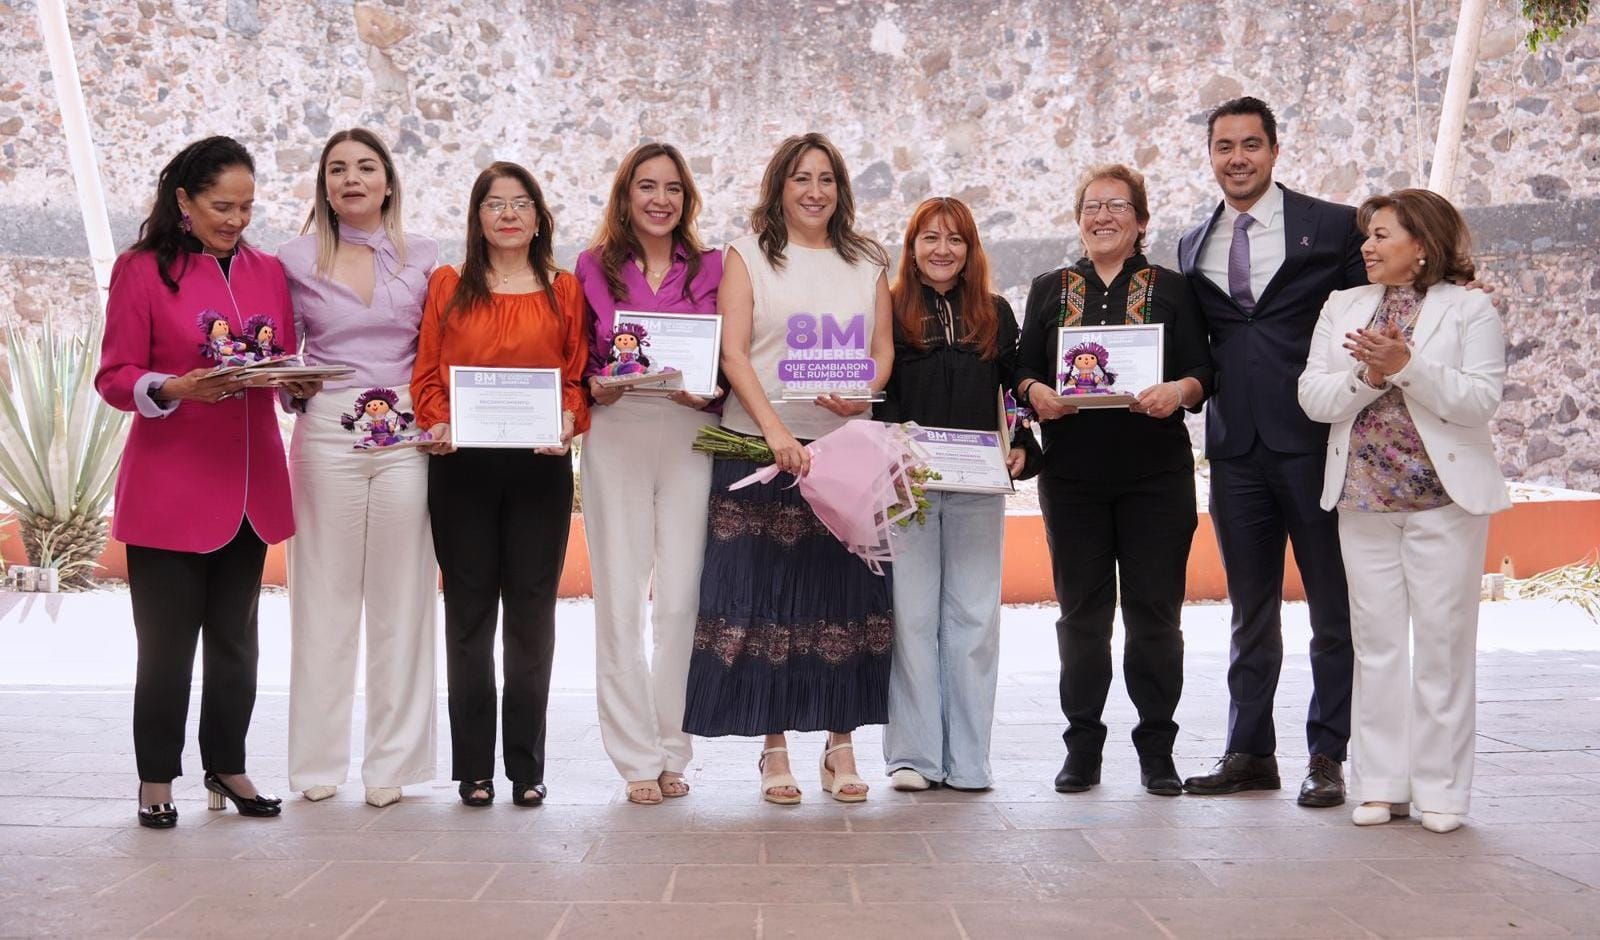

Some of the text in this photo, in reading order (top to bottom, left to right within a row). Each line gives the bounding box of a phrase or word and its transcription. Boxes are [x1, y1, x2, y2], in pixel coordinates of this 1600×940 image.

[786, 313, 865, 349] 8M
[788, 349, 866, 360] MUJERES
[785, 363, 868, 372] QUE CAMBIARON
[474, 372, 496, 382] 8M
[927, 431, 947, 440] 8M
